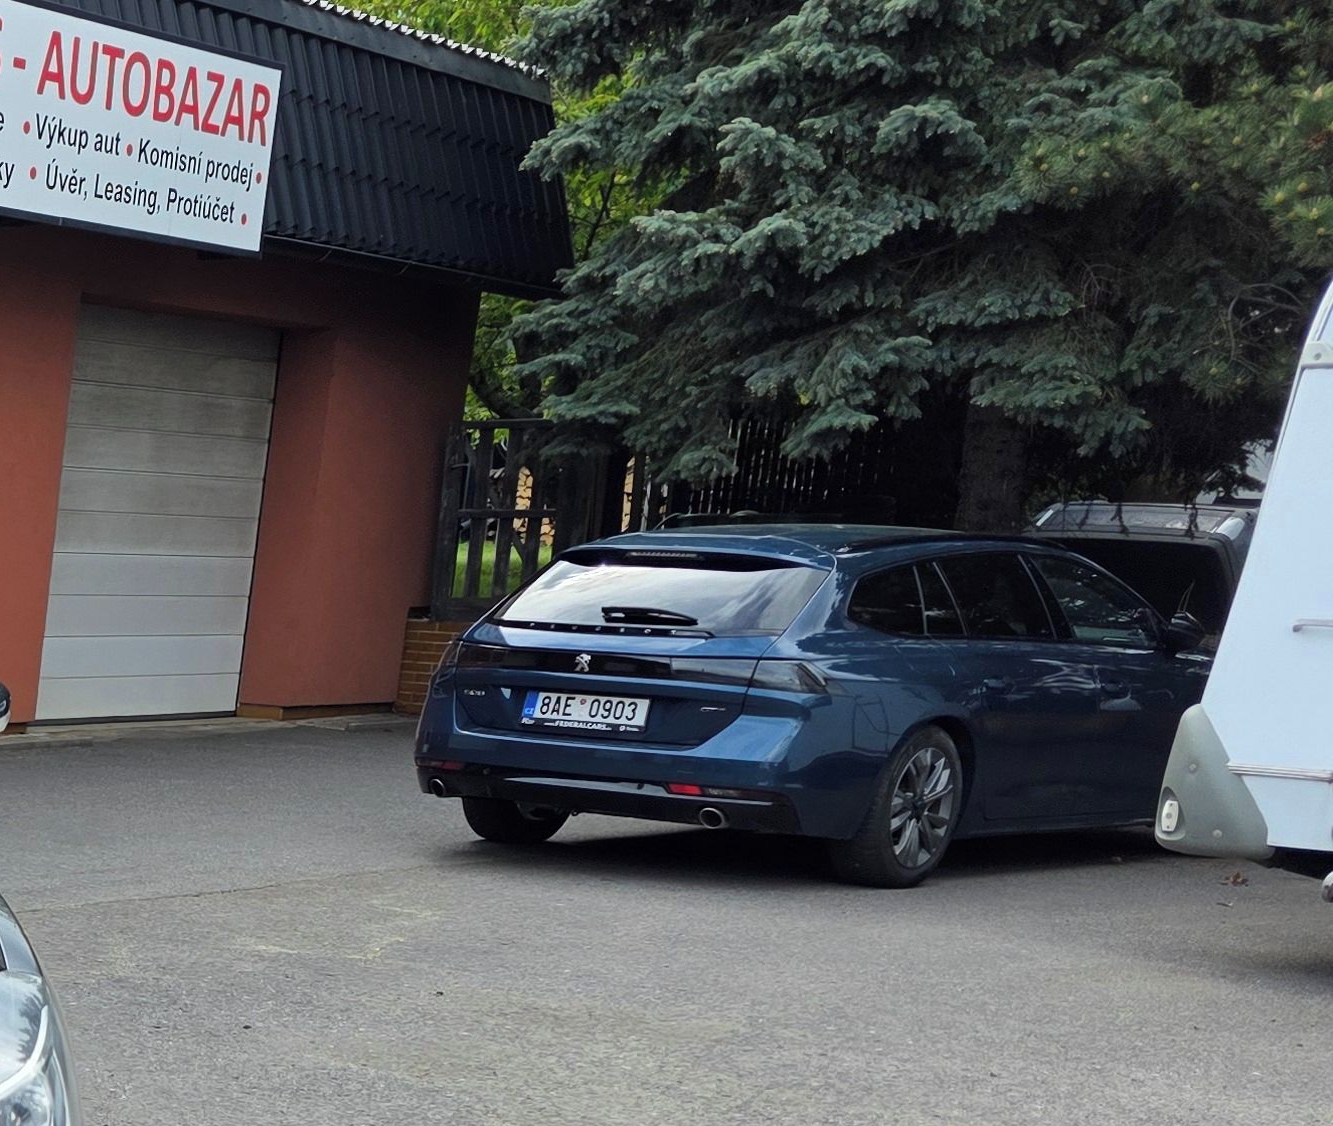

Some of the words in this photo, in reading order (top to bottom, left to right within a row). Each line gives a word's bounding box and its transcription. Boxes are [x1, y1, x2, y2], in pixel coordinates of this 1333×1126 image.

[37, 31, 271, 146] AUTOBAZAR
[36, 113, 88, 155] Výkup
[94, 132, 121, 156] aut
[137, 138, 202, 175] Komisní
[205, 158, 254, 192] prodej
[45, 158, 87, 201] Úvěr,
[94, 173, 160, 215] Leasing,
[166, 187, 235, 224] Protiúčet
[539, 695, 576, 716] 8AE
[588, 698, 639, 721] 0903
